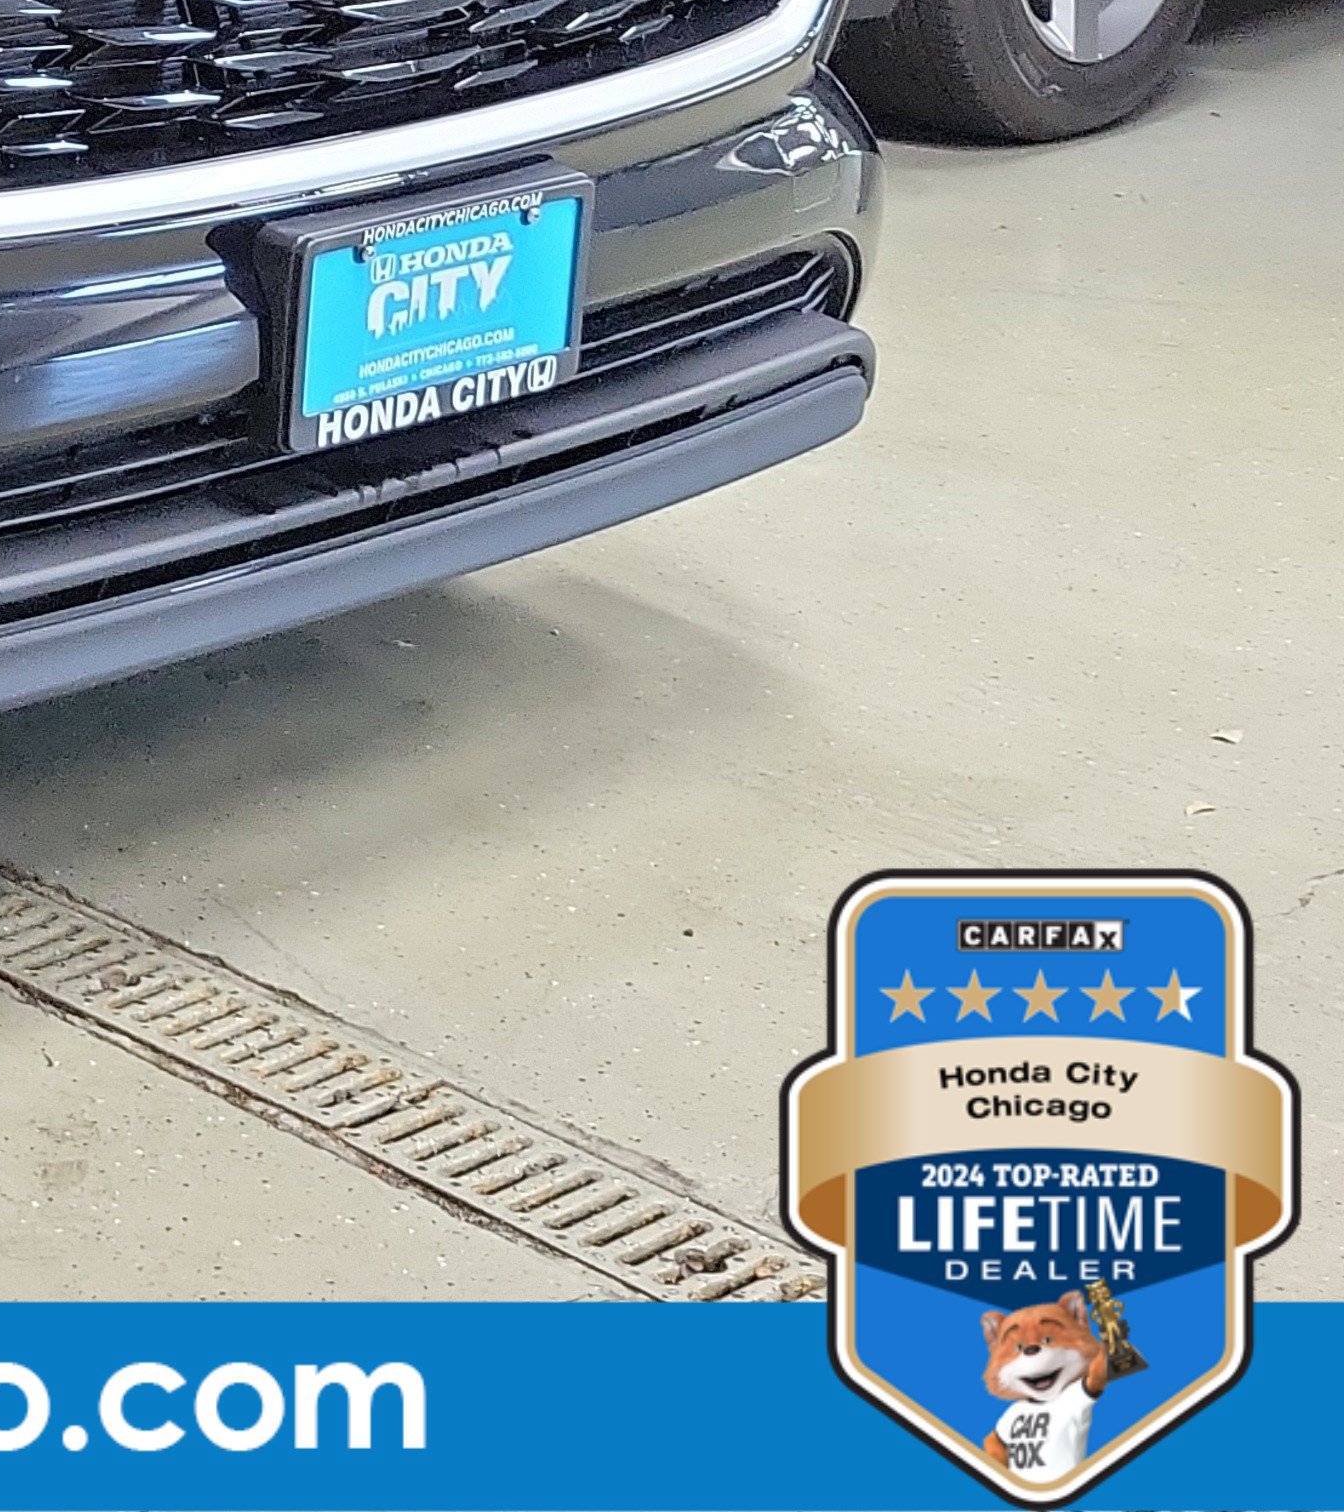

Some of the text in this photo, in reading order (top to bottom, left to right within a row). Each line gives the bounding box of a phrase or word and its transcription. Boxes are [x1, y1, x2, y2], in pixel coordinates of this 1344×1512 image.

[362, 191, 543, 245] HONDACITYCHICAGO.COM
[398, 231, 514, 275] HONDA
[367, 254, 513, 340] CITY
[358, 328, 515, 379] HONDACITYCHICAGO.COM
[318, 362, 528, 448] HONDA CITY
